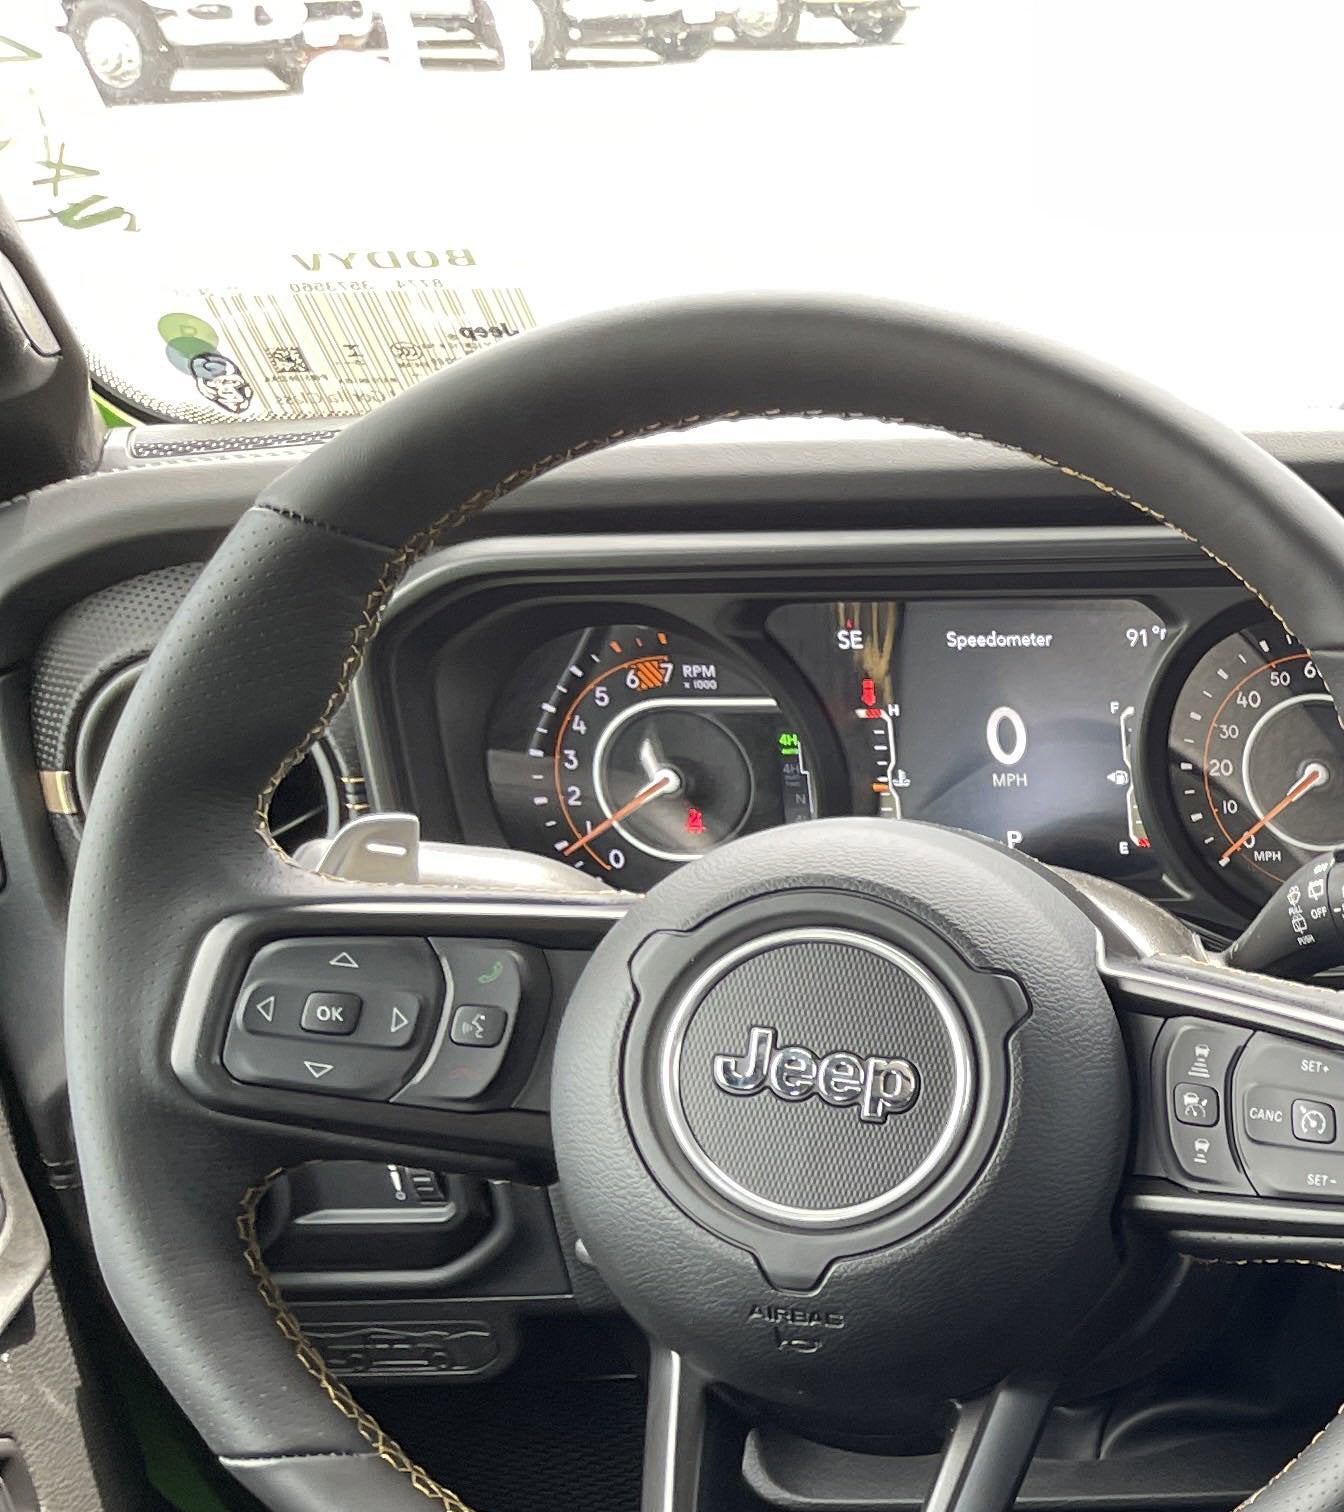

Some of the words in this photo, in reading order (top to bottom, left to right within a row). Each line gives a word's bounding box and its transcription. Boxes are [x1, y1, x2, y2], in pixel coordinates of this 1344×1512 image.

[837, 630, 864, 650] SE
[946, 630, 1053, 649] Speedometer
[625, 671, 639, 689] 6
[661, 663, 674, 683] 7
[682, 664, 717, 679] RPM
[1270, 671, 1291, 686] 50
[595, 687, 610, 707] 5
[1236, 691, 1262, 709] 40
[888, 704, 900, 716] H
[1110, 702, 1120, 714] F
[572, 715, 587, 735] 4
[1219, 725, 1239, 739] 30
[986, 706, 1027, 765] 0
[564, 749, 579, 770] 3
[1209, 759, 1234, 777] 20
[992, 773, 1028, 787] MPH
[567, 787, 582, 806] 2
[1222, 800, 1238, 815] 10
[1008, 831, 1023, 849] P
[1120, 842, 1129, 855] E
[609, 849, 625, 869] 0
[1254, 850, 1282, 862] MPH
[1310, 906, 1328, 919] OFF
[316, 1006, 344, 1023] OK
[713, 1025, 921, 1124] Jeep
[1249, 1107, 1283, 1123] CANC
[747, 1303, 845, 1329] AIRBAG
